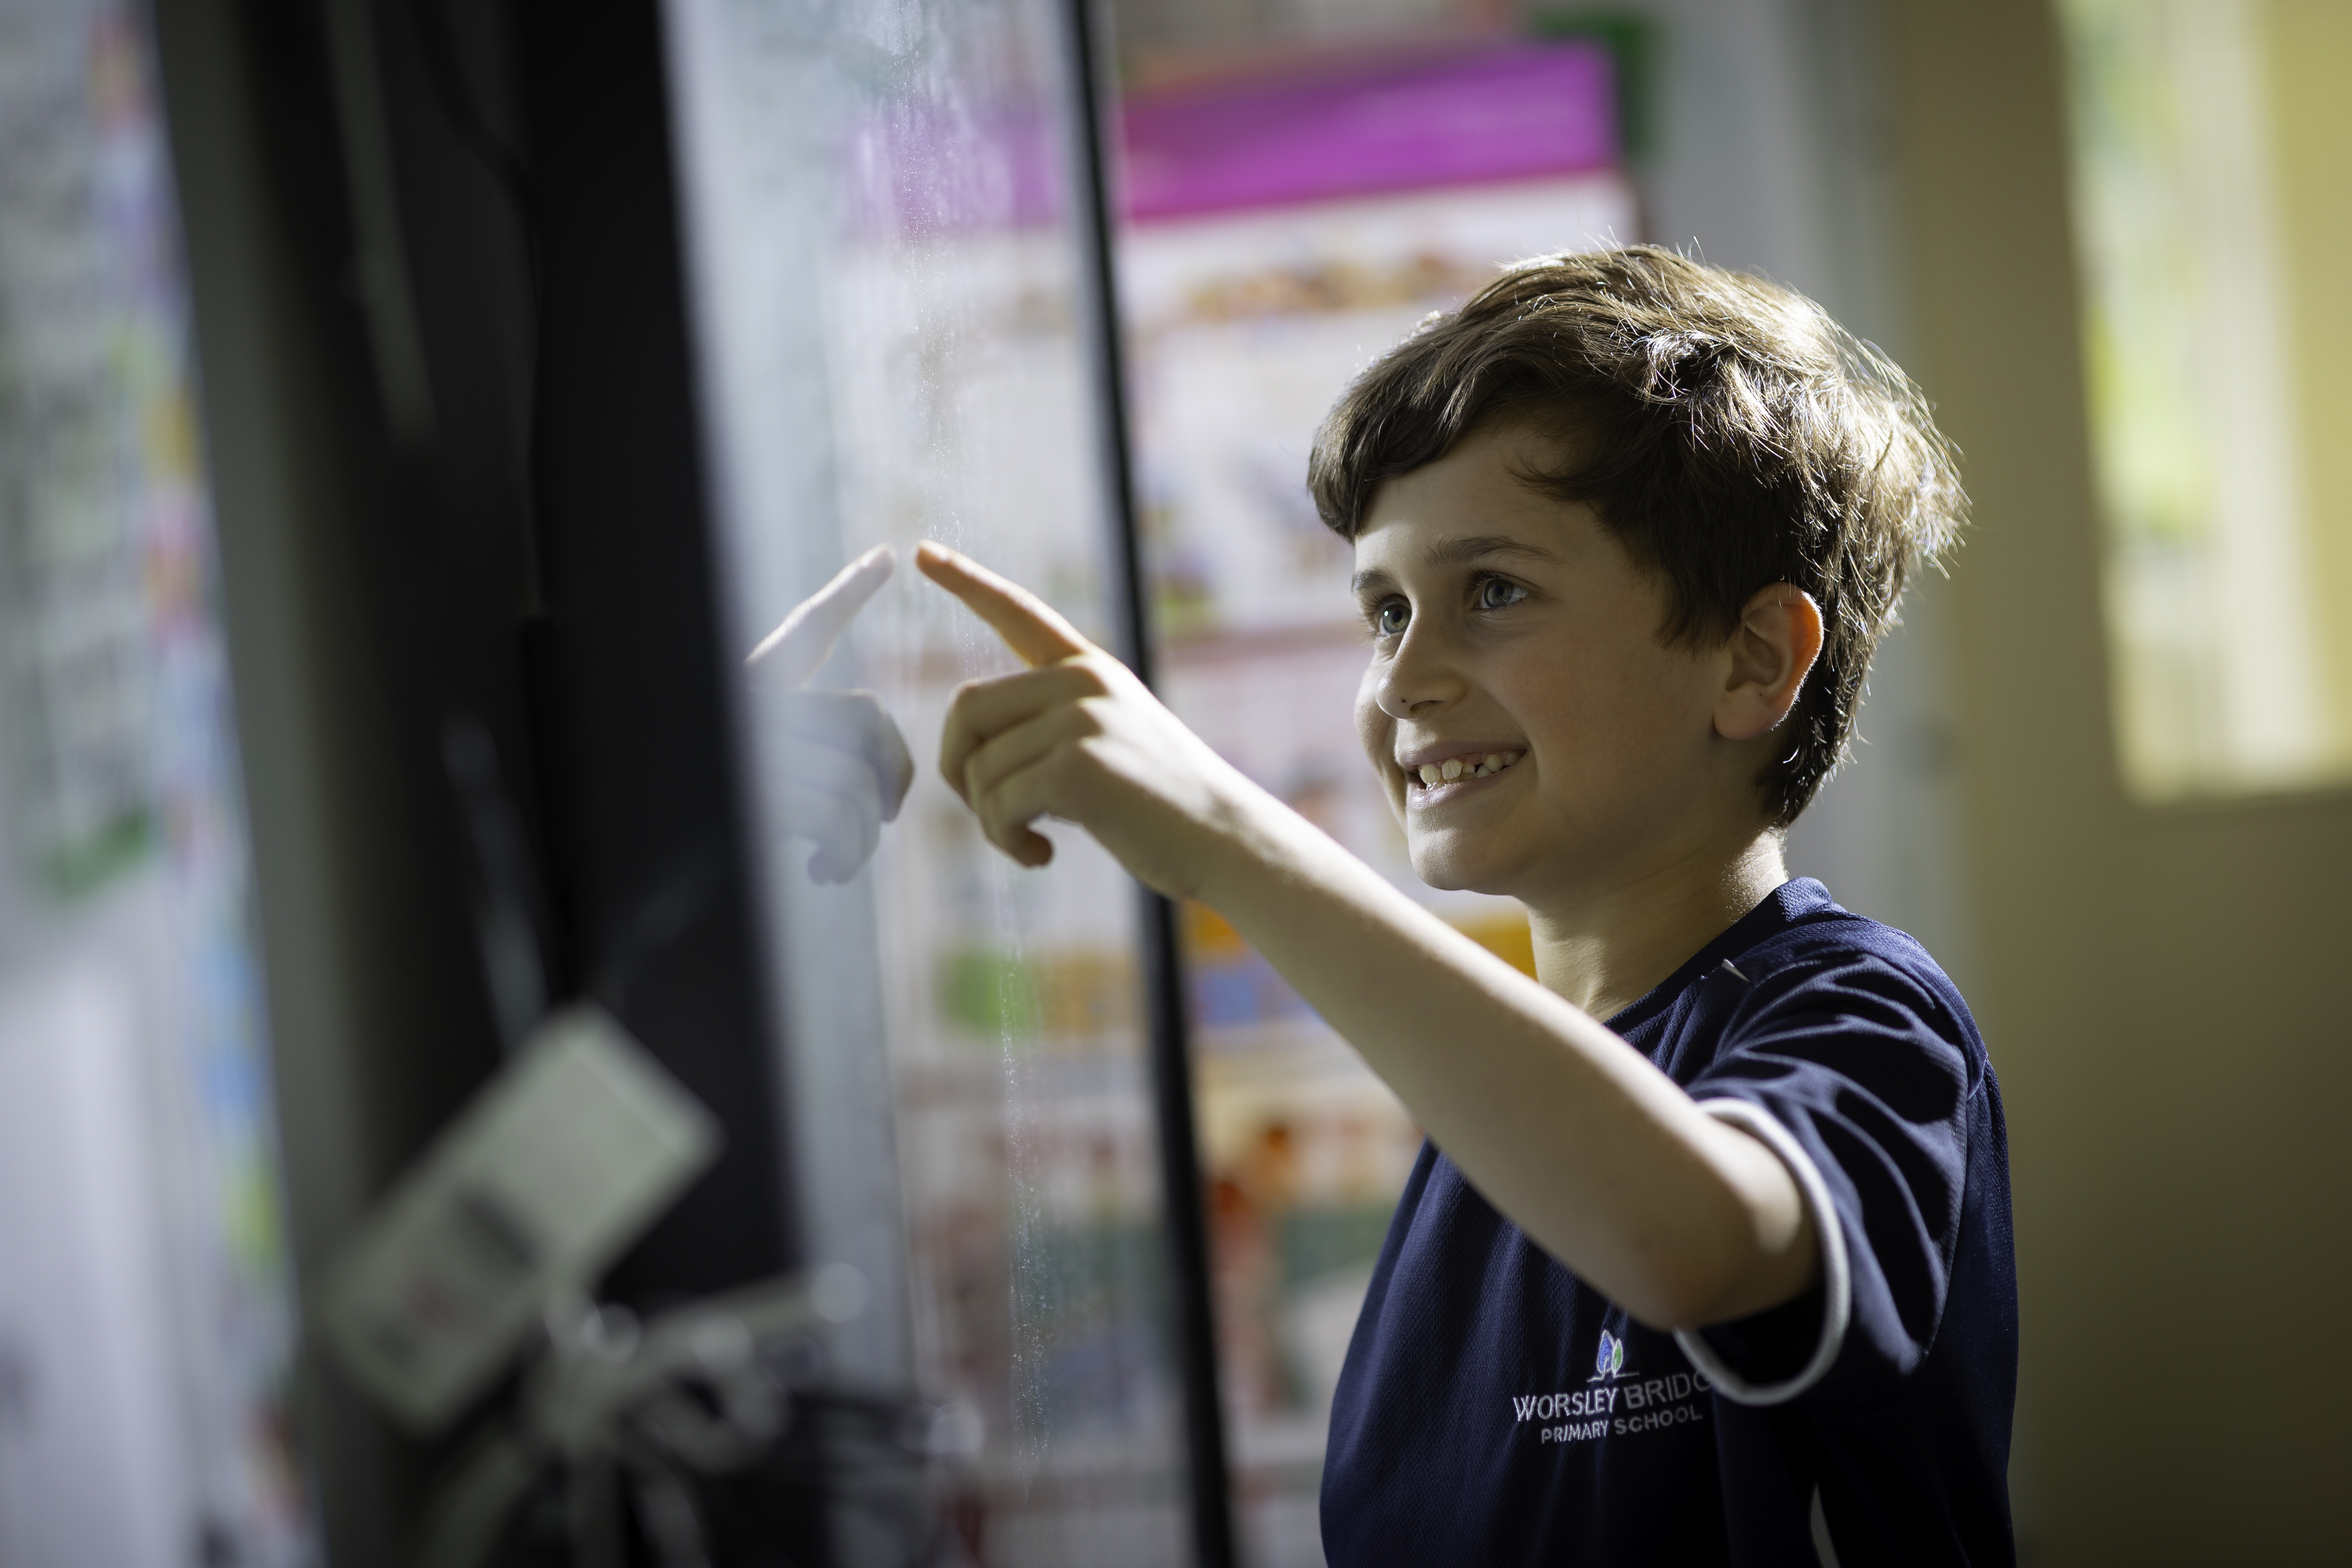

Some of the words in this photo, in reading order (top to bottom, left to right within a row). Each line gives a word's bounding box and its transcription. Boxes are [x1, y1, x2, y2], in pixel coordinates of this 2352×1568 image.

[1513, 1387, 1619, 1421] WORSLEY
[1623, 1372, 1712, 1410] BRIDG
[1541, 1420, 1609, 1444] PRIMARY
[1614, 1405, 1703, 1435] SCHOOL
